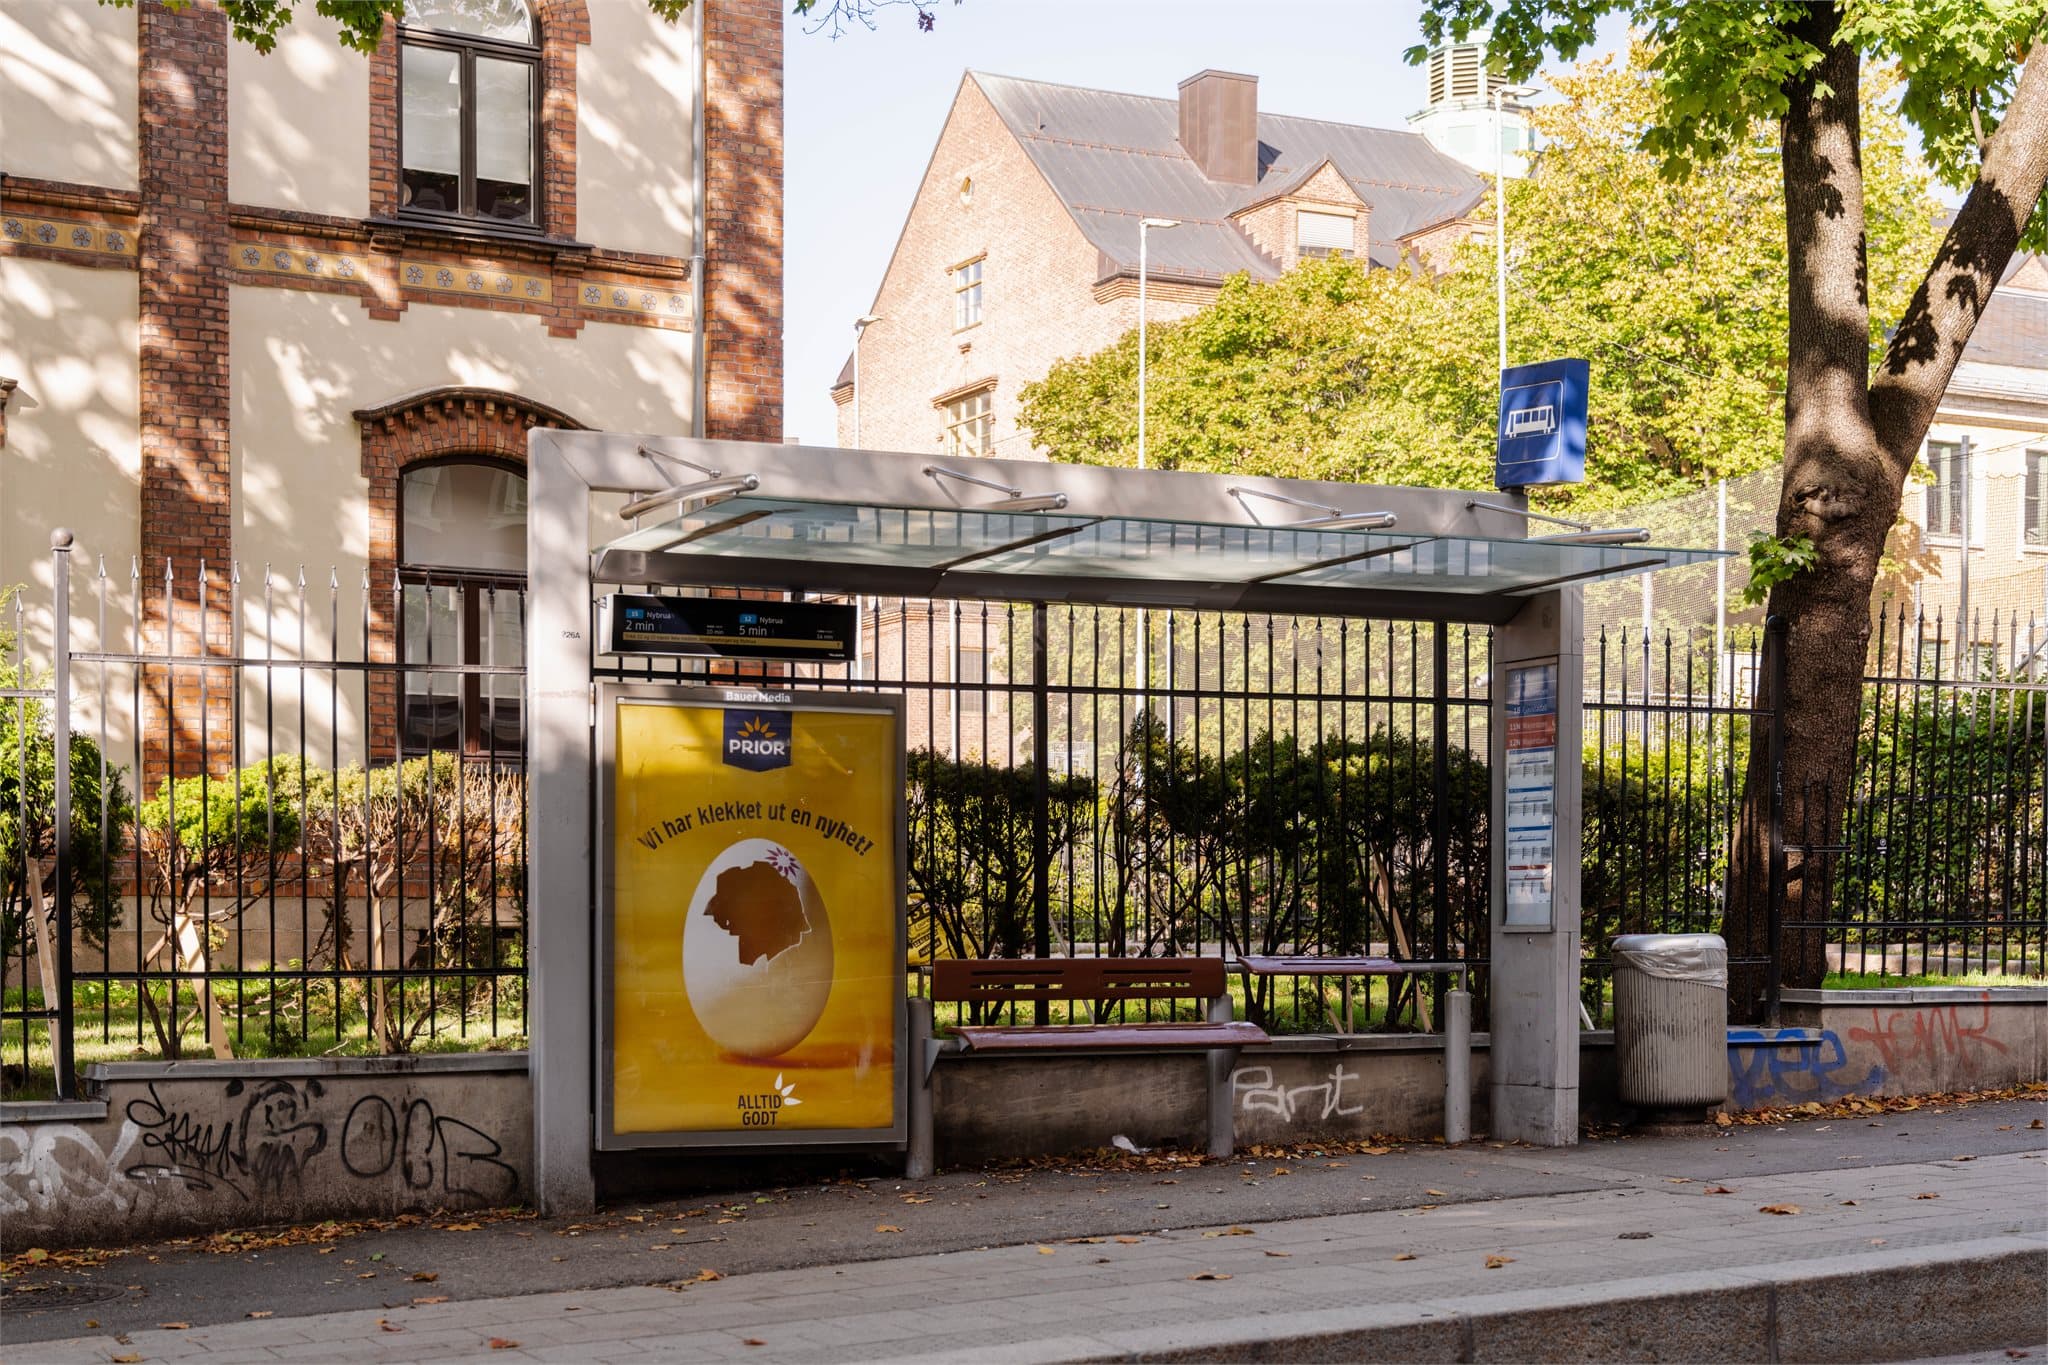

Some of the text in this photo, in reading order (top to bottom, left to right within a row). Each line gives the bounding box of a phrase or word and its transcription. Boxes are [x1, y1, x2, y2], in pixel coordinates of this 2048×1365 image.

[625, 619, 655, 631] 2 min
[759, 616, 784, 625] Nybrua
[739, 625, 767, 636] 5 min
[726, 691, 791, 703] Bauer Media
[728, 738, 786, 757] PRIOR
[637, 800, 875, 857] Vi har klekket ut en nyhet!
[737, 1094, 782, 1109] ALLTID
[742, 1111, 778, 1126] GODT
